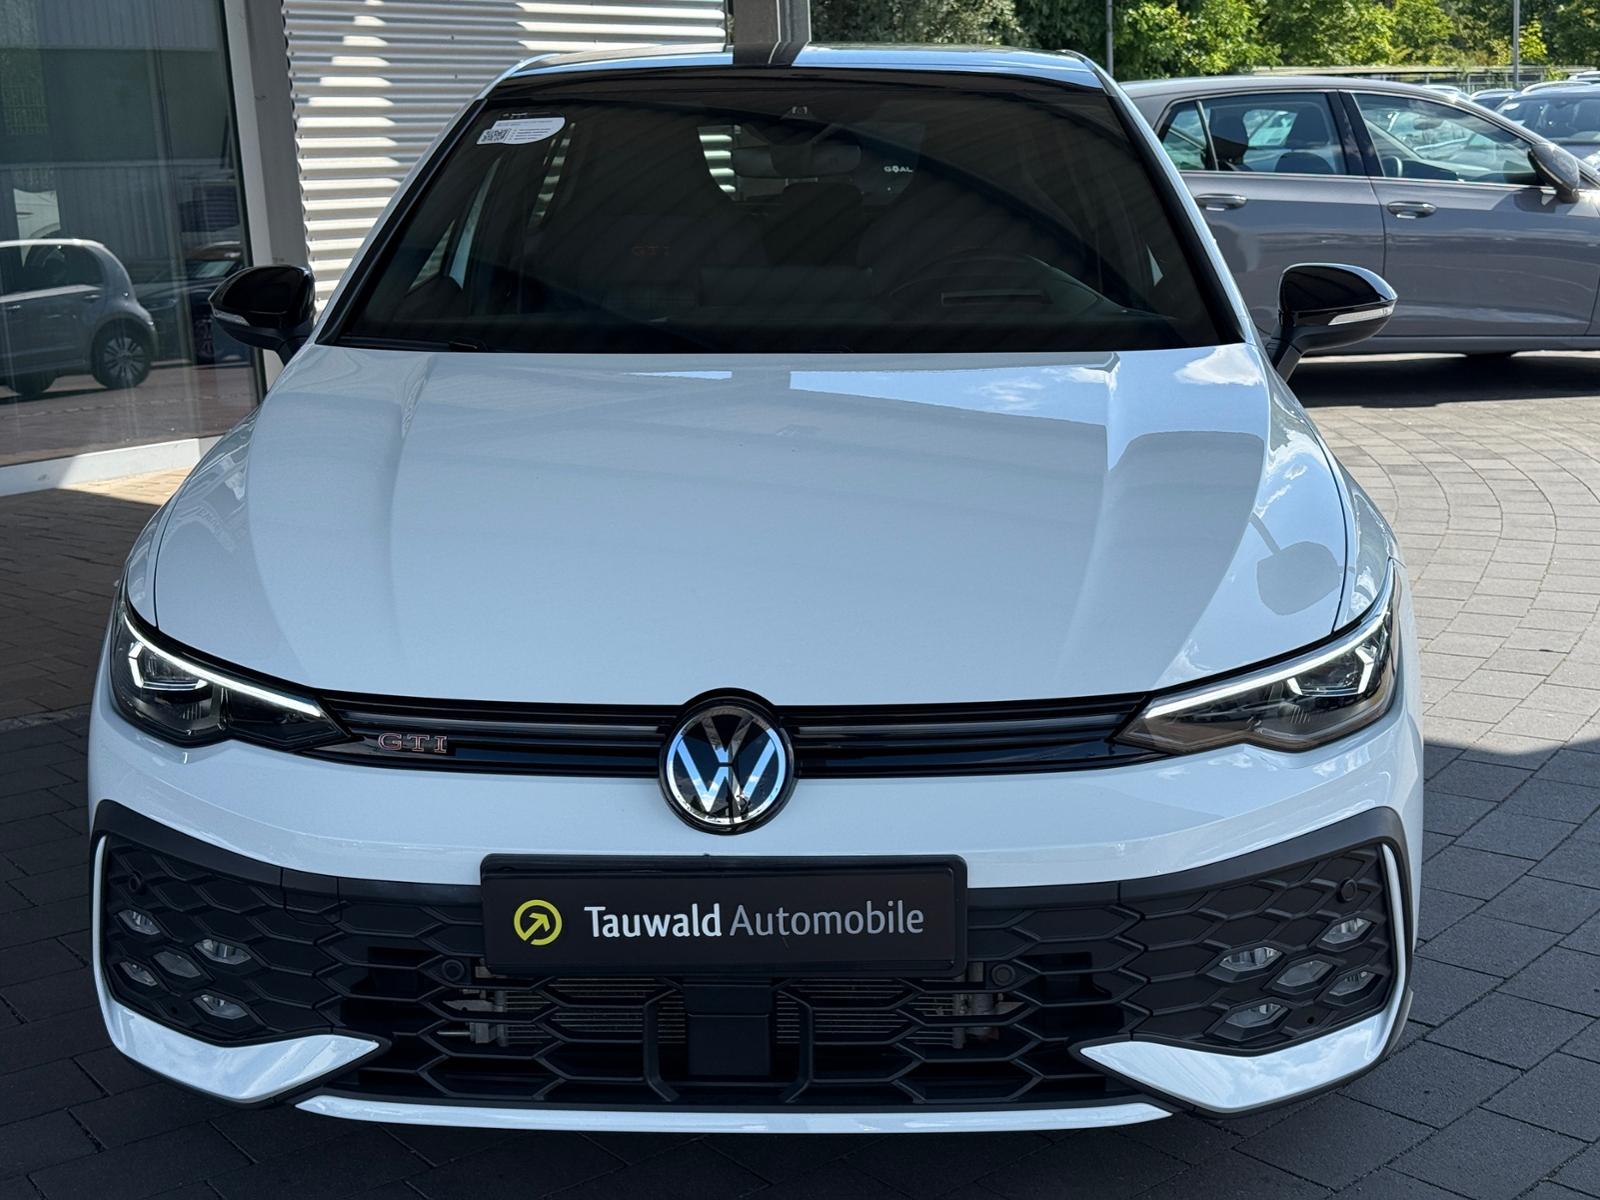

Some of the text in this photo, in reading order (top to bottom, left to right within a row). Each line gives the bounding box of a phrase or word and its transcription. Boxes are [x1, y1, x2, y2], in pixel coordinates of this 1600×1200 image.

[377, 732, 448, 754] GTI
[583, 900, 925, 938] Tauwald Automobile
